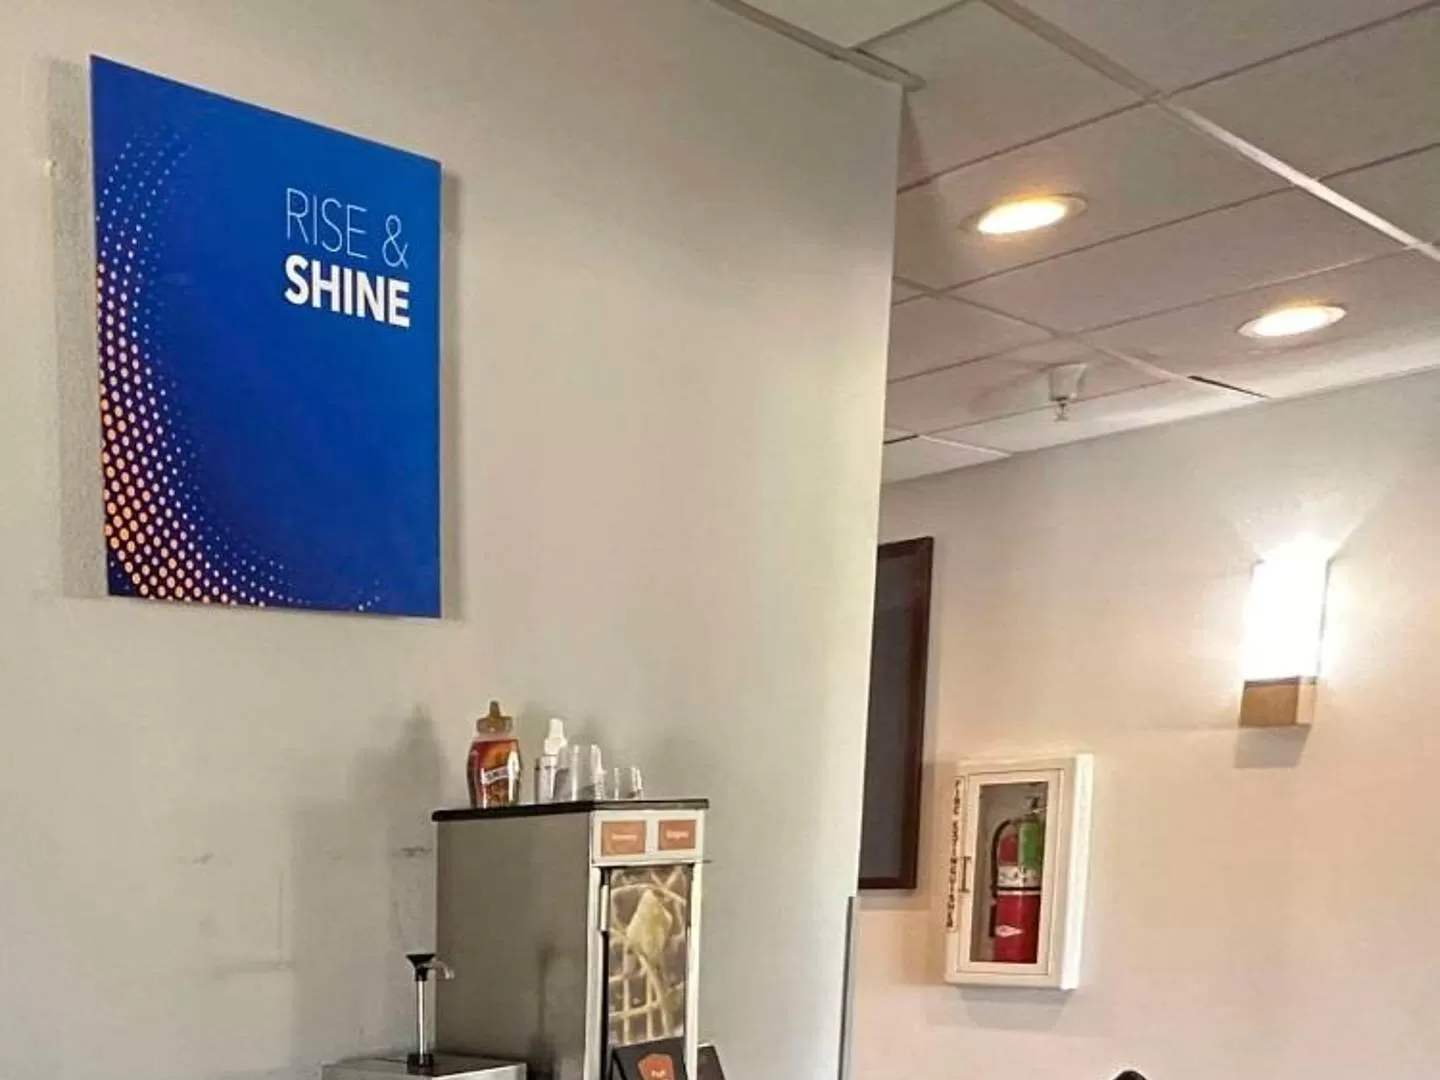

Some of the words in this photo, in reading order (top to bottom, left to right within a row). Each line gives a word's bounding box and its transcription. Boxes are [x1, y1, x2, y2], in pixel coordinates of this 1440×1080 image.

[285, 187, 369, 260] RISE
[381, 214, 409, 269] &
[284, 253, 411, 328] SHINE
